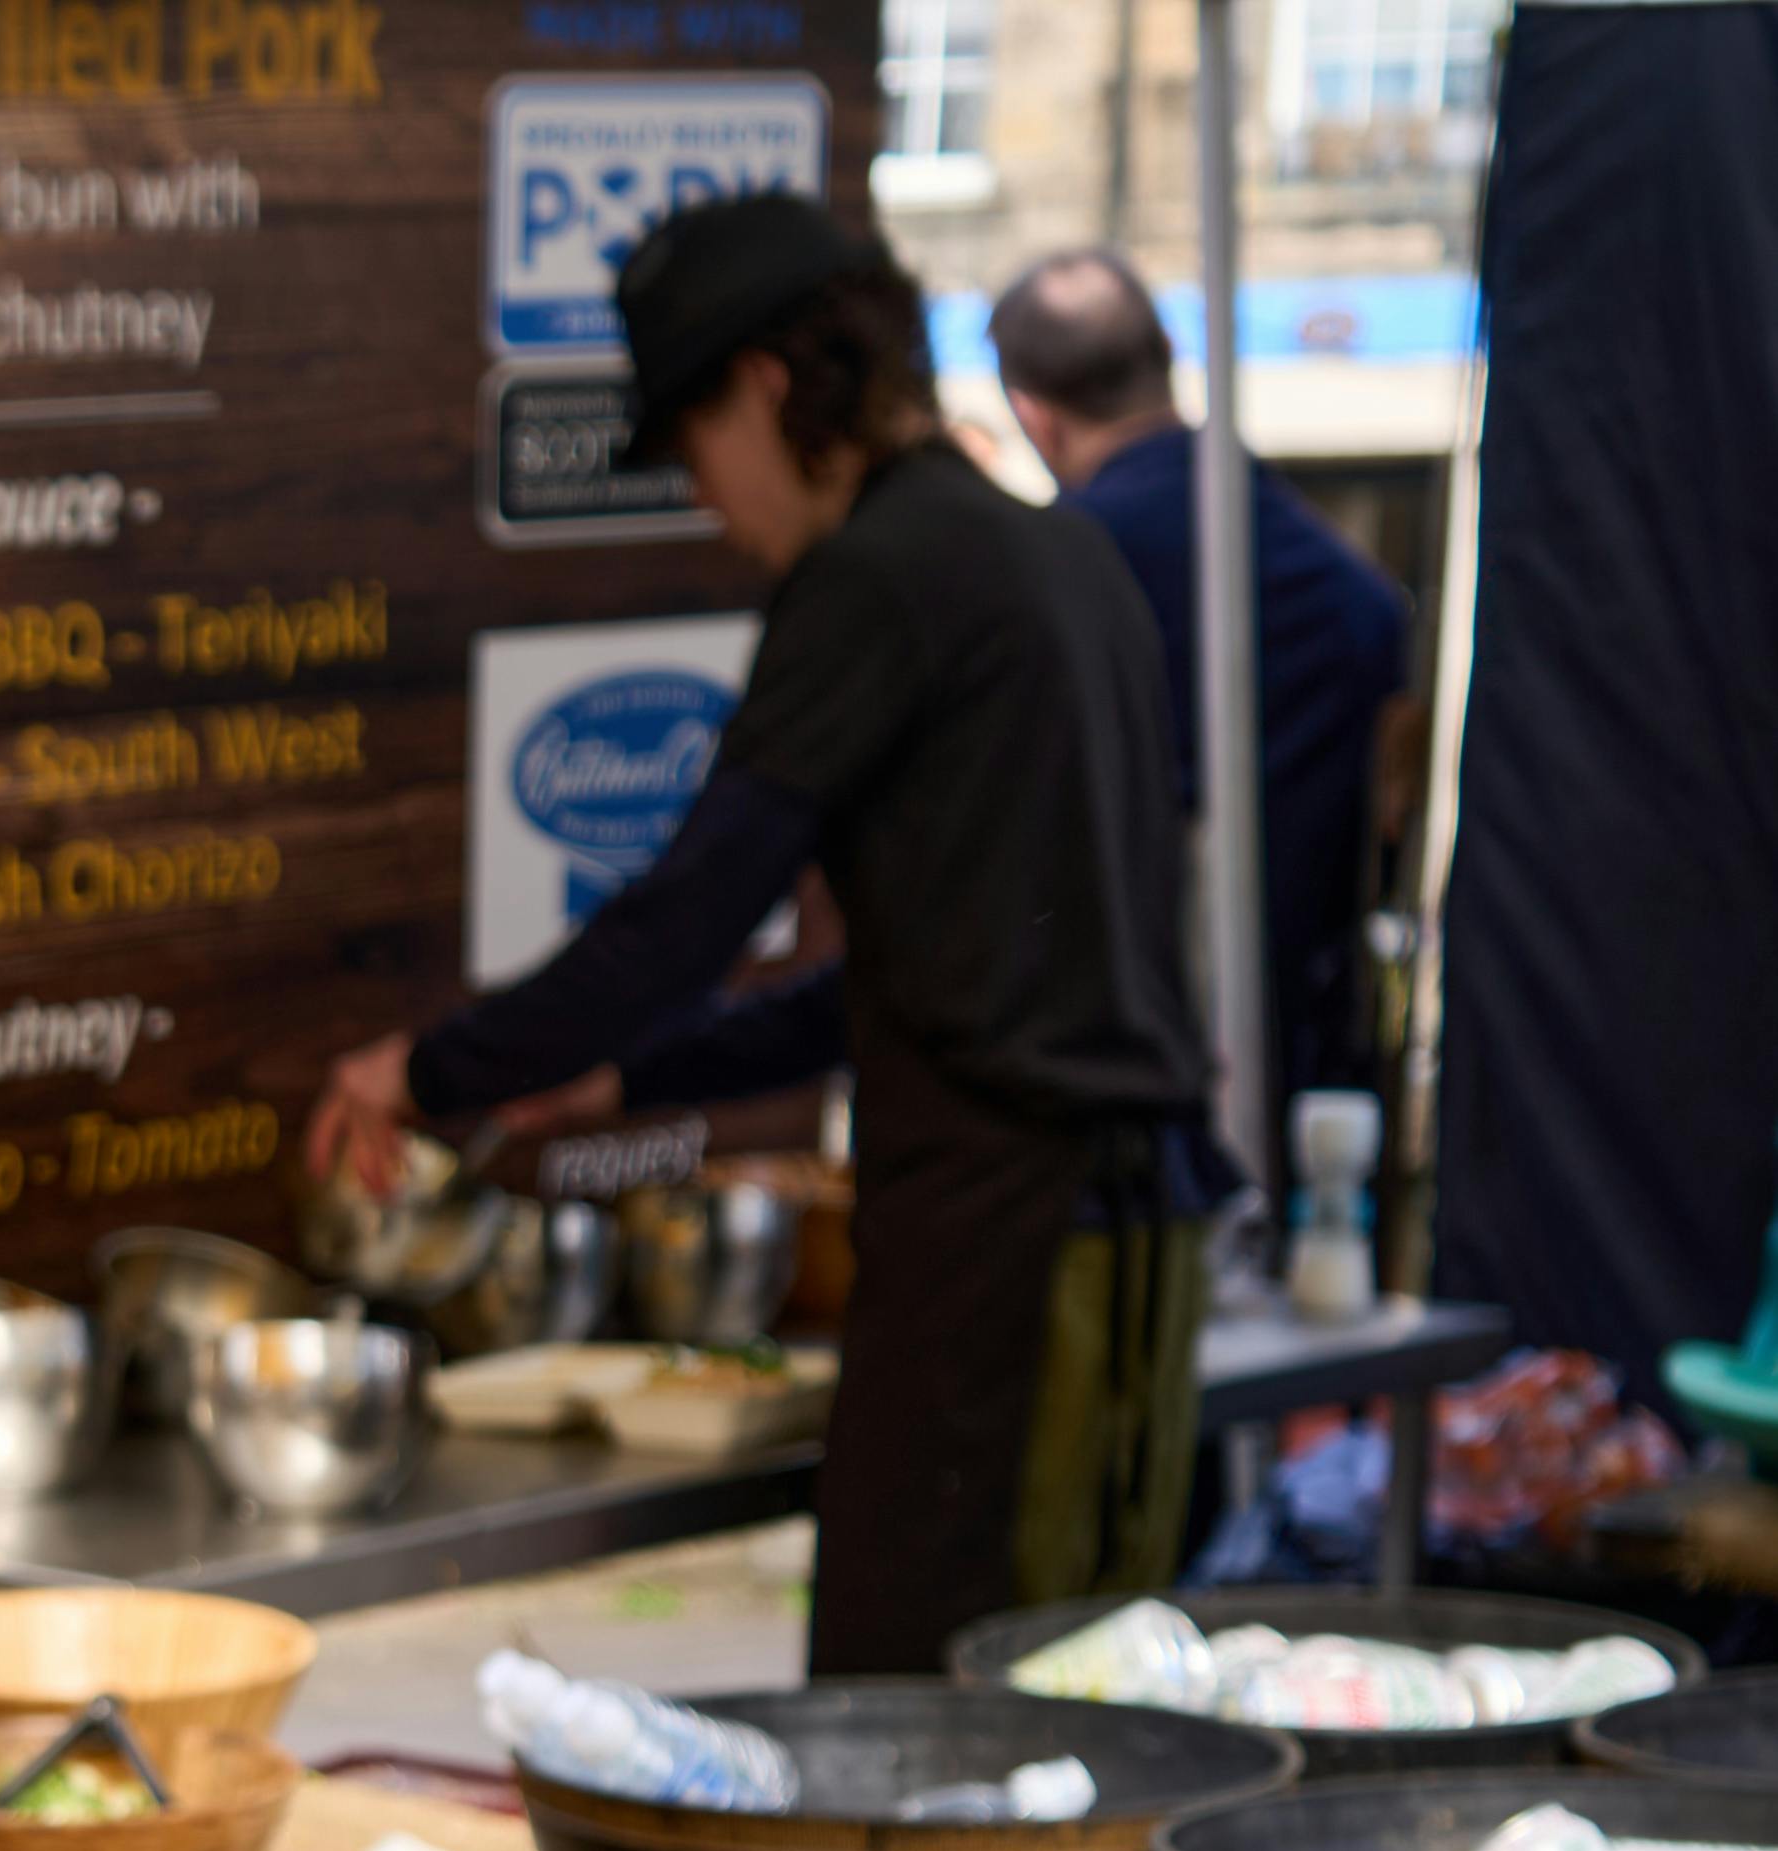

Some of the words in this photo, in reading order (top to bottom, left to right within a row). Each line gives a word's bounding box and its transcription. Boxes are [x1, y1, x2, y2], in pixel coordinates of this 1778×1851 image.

[187, 0, 381, 98] Pork
[125, 147, 260, 236] with
[149, 577, 388, 684] Teriyaki
[15, 707, 199, 803] South
[203, 702, 366, 784] West
[49, 826, 282, 920] Chorizo
[66, 1095, 281, 1200] Tomato
